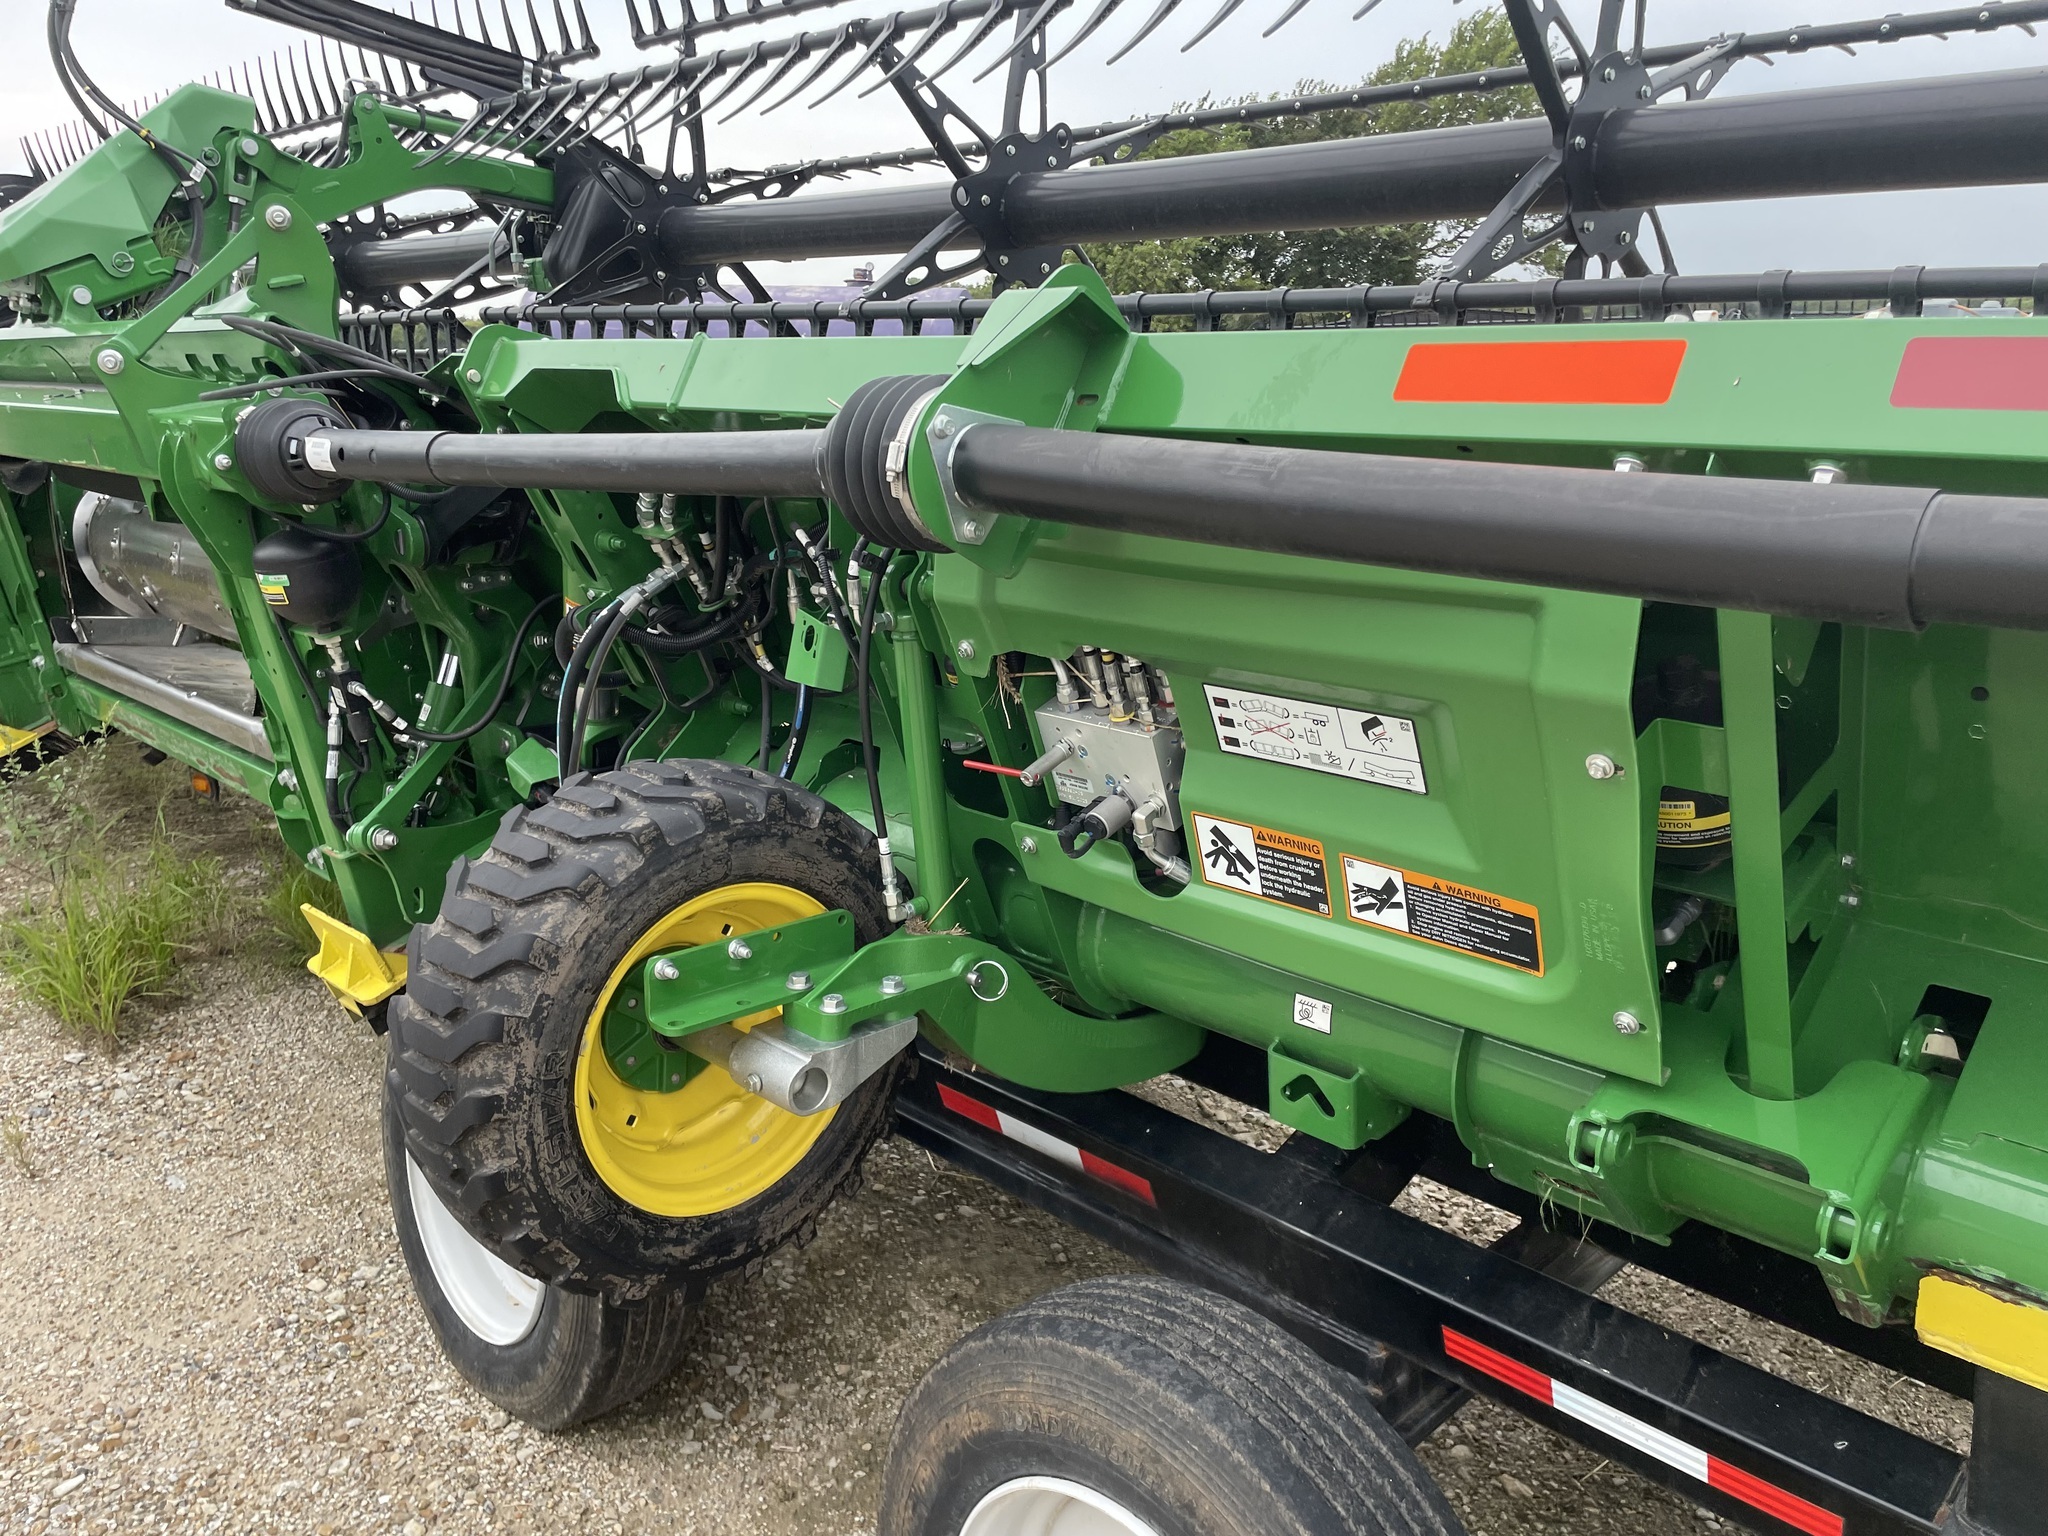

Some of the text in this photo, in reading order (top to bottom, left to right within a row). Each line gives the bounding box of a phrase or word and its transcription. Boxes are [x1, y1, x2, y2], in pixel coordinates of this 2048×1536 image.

[1657, 821, 1692, 830] UTION
[1266, 832, 1321, 855] WARNING
[1256, 847, 1273, 857] Avoid
[1273, 852, 1295, 863] serious
[1295, 857, 1313, 869] injury
[1257, 855, 1317, 877] death from crushing.
[1258, 863, 1302, 881] Before working
[1260, 871, 1326, 895] underneath the header,
[1261, 879, 1311, 898] lock the hydraulic
[1262, 887, 1285, 899] system.
[1445, 884, 1502, 908] WARNING
[1491, 908, 1514, 919] hydraulic
